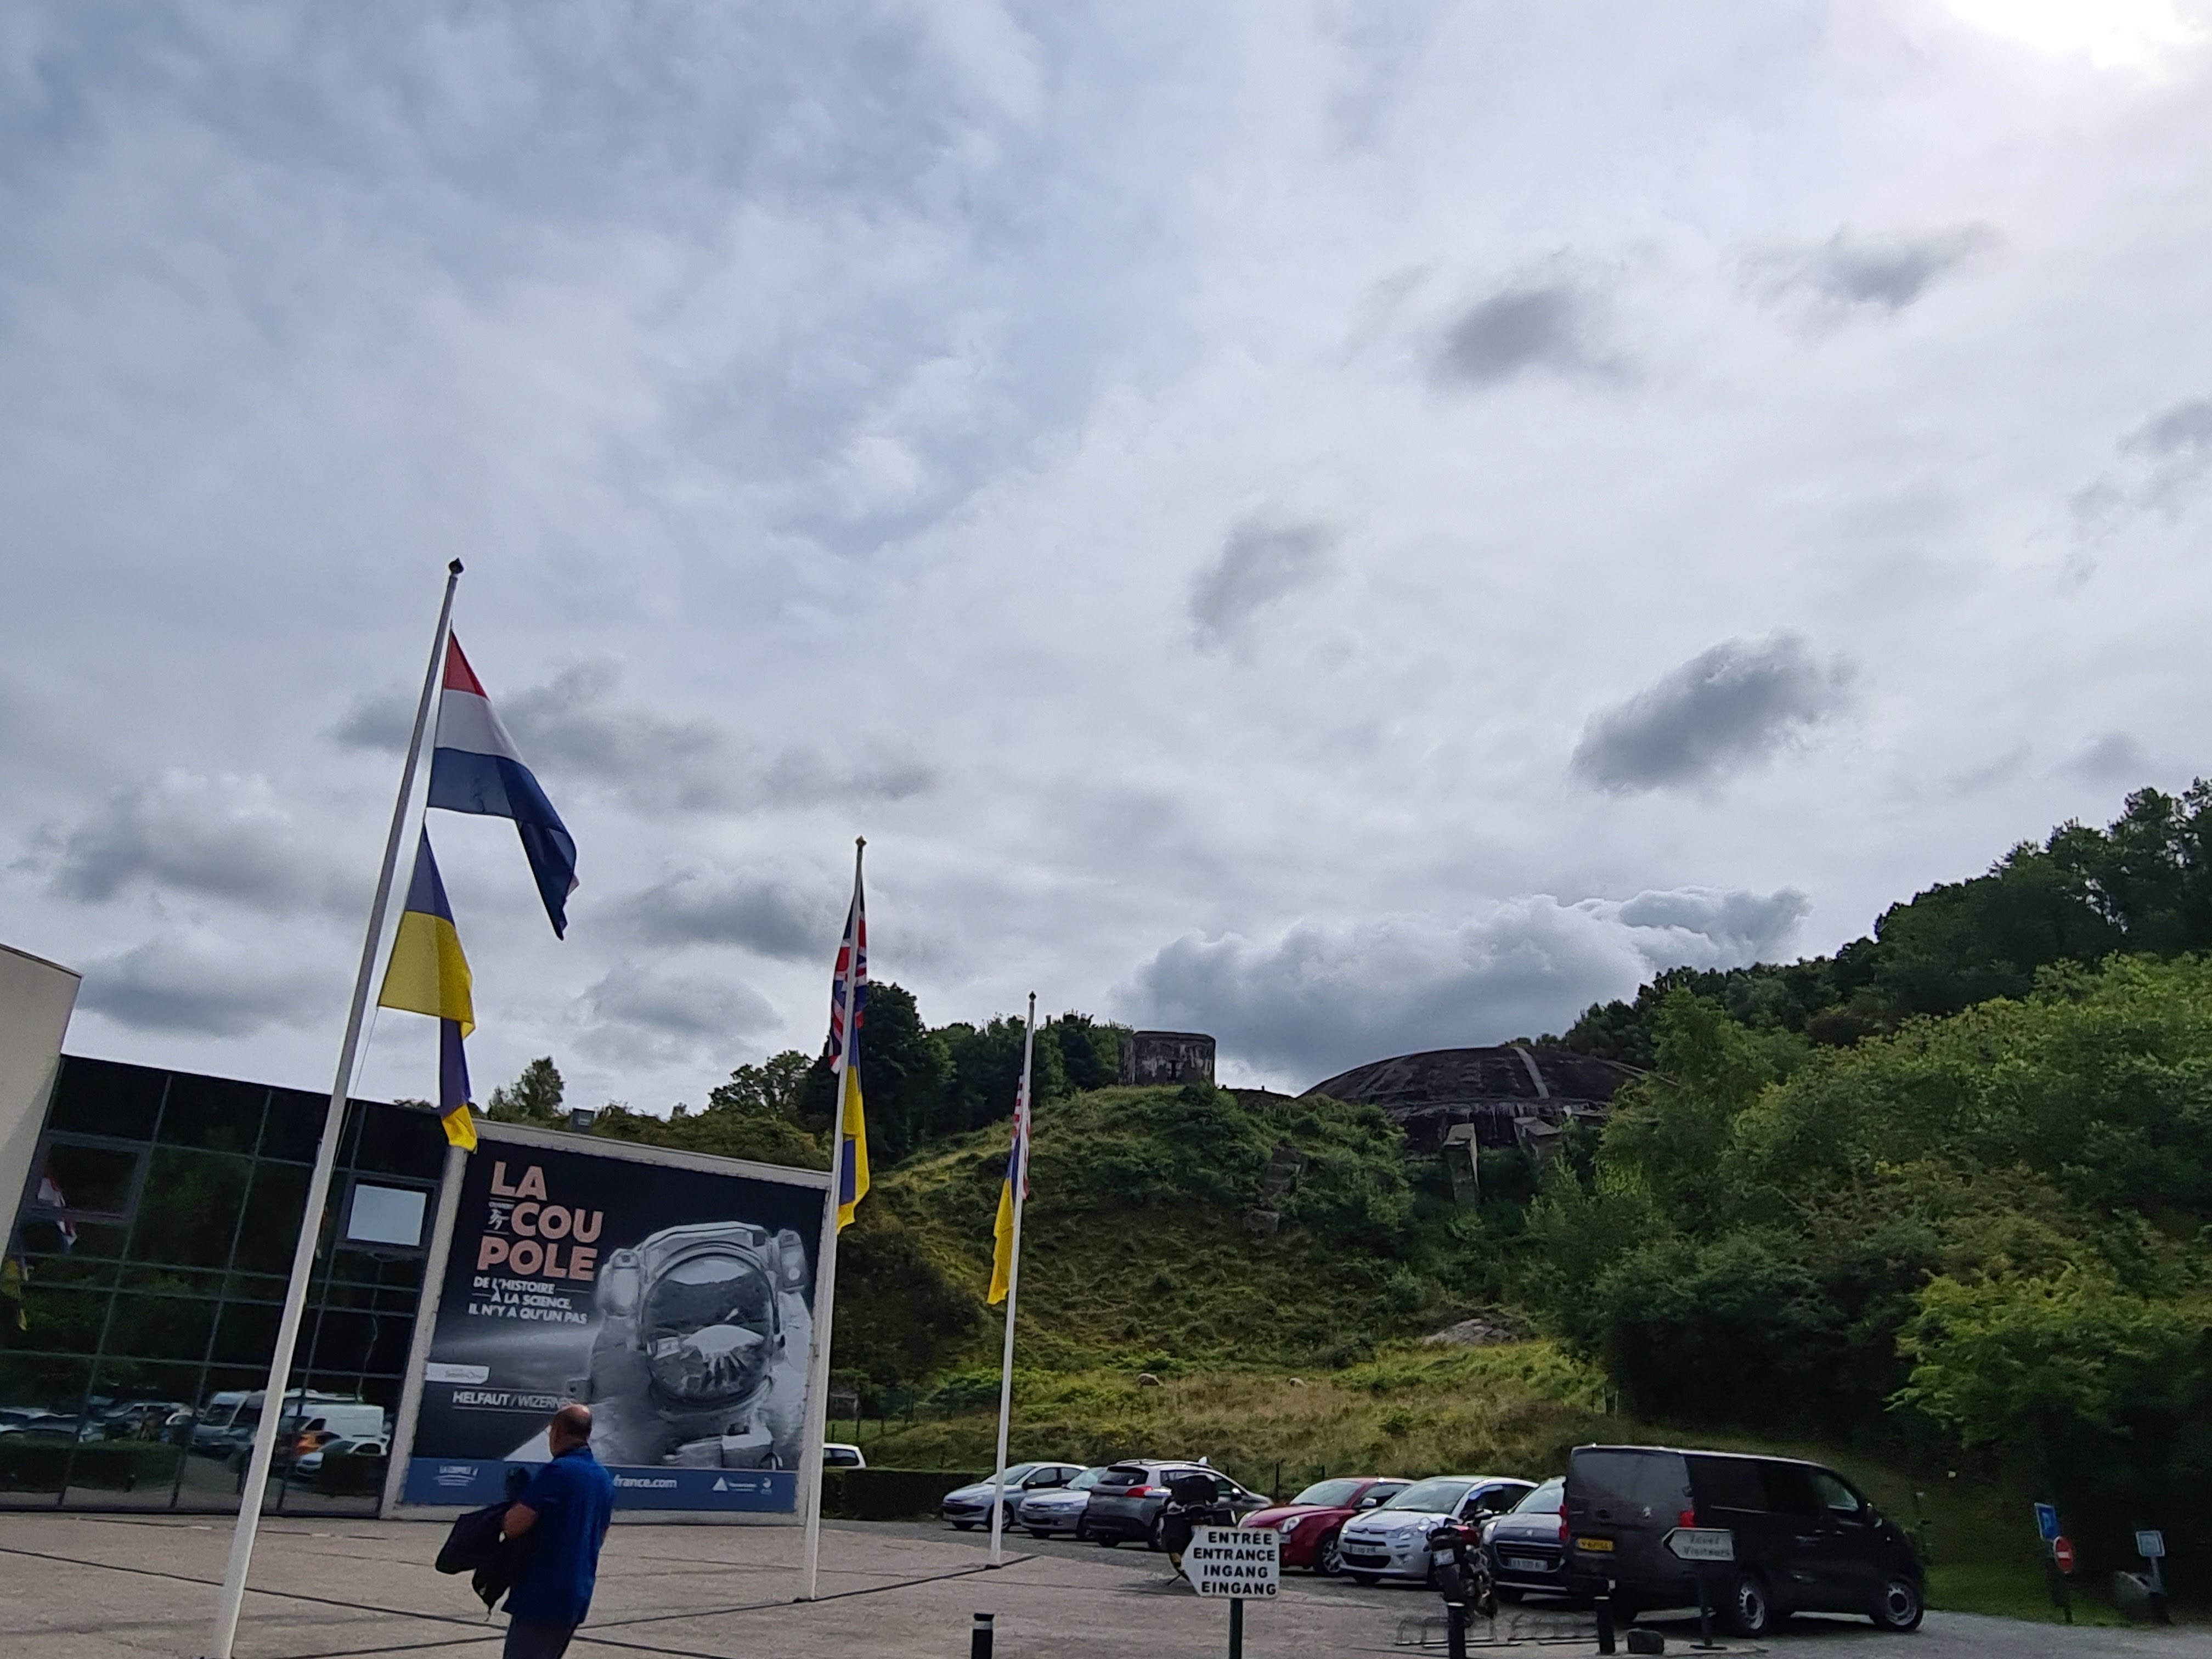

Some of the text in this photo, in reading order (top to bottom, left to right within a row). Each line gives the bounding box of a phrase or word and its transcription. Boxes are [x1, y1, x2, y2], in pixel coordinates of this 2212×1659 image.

[490, 1160, 548, 1201] LA
[511, 1201, 603, 1243] COU
[476, 1235, 598, 1281] POLE
[473, 1276, 555, 1294] DE L'HISTOIRE
[504, 1293, 520, 1305] LA
[468, 1303, 588, 1324] IL N'Y A QU'UN PAS
[452, 1391, 511, 1406] HELFAUT
[1208, 1531, 1273, 1545] ENTRÉE
[1193, 1547, 1276, 1561] ENTRANCE
[1204, 1565, 1268, 1578] INGANG
[1201, 1581, 1277, 1595] EINGANG
